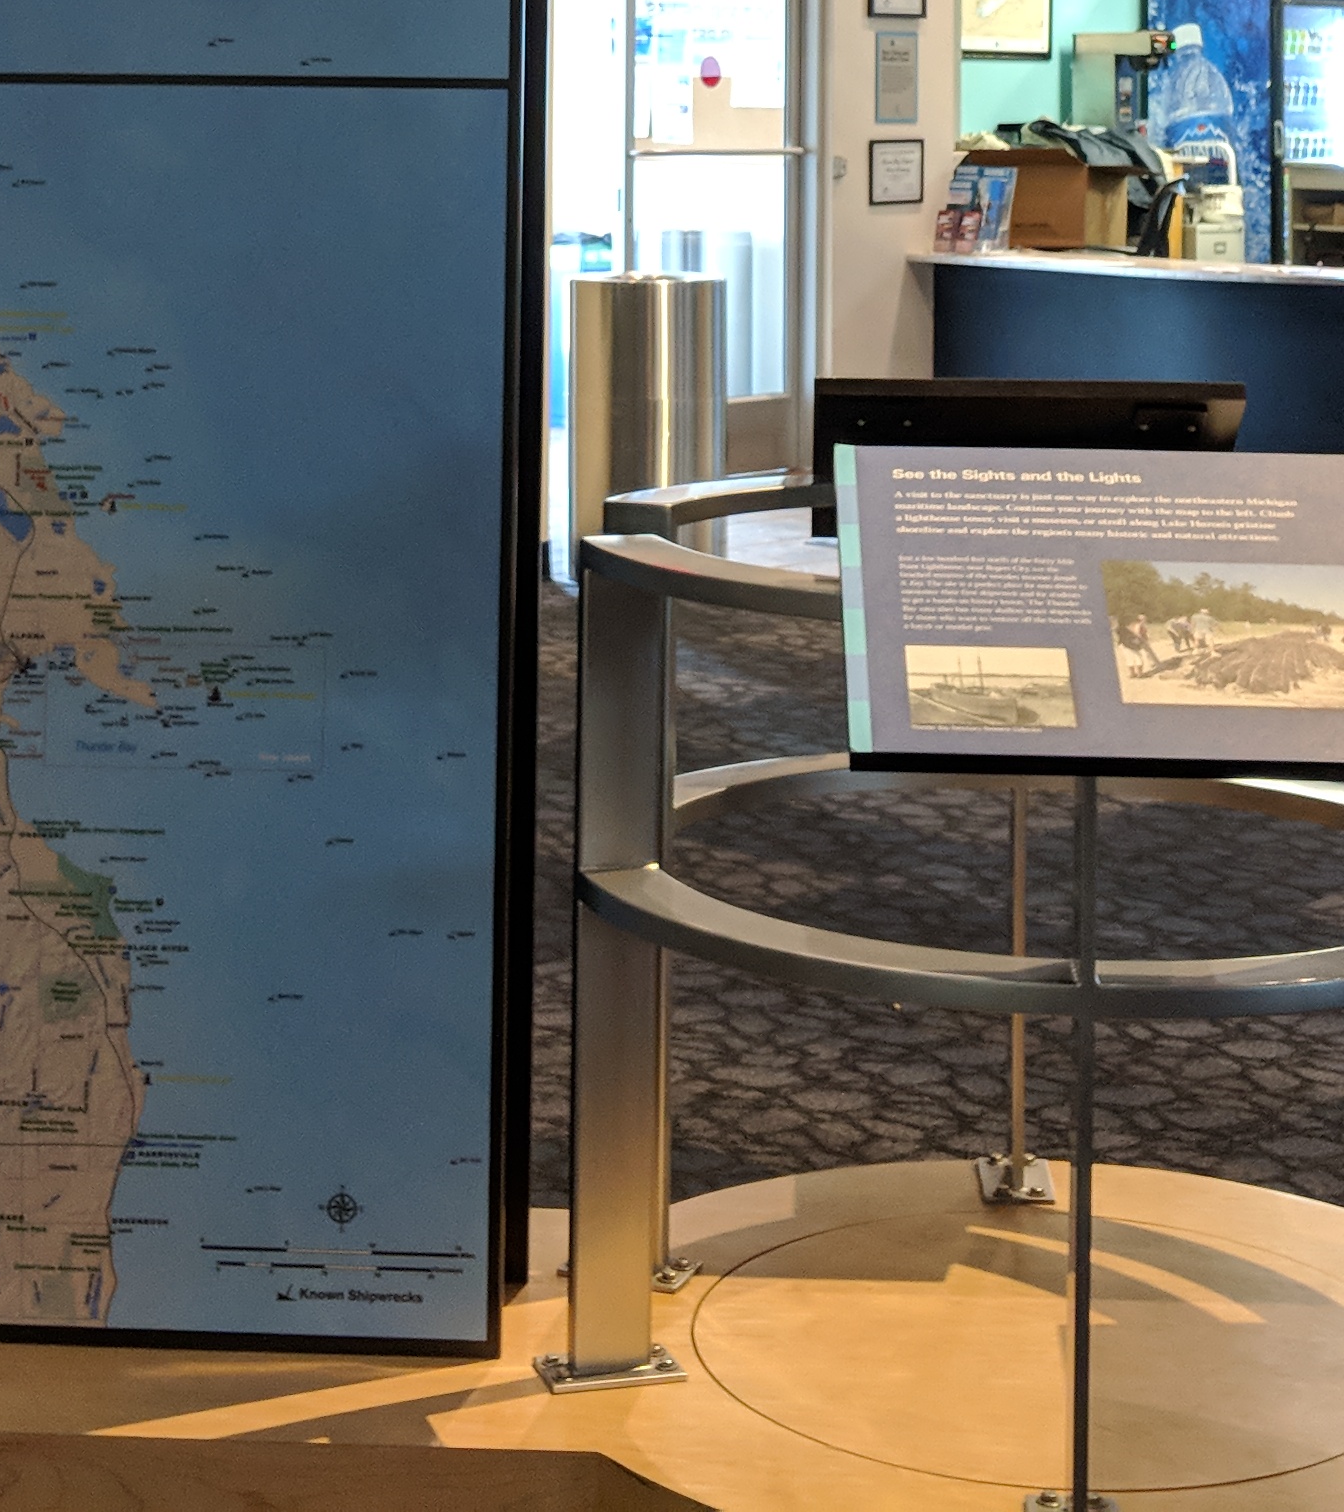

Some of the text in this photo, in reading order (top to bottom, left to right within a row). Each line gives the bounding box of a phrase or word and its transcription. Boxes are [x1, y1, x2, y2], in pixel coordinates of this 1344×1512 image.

[891, 467, 1142, 485] See the Sights and the Lights
[299, 1288, 423, 1305] Known Shipwrecks
